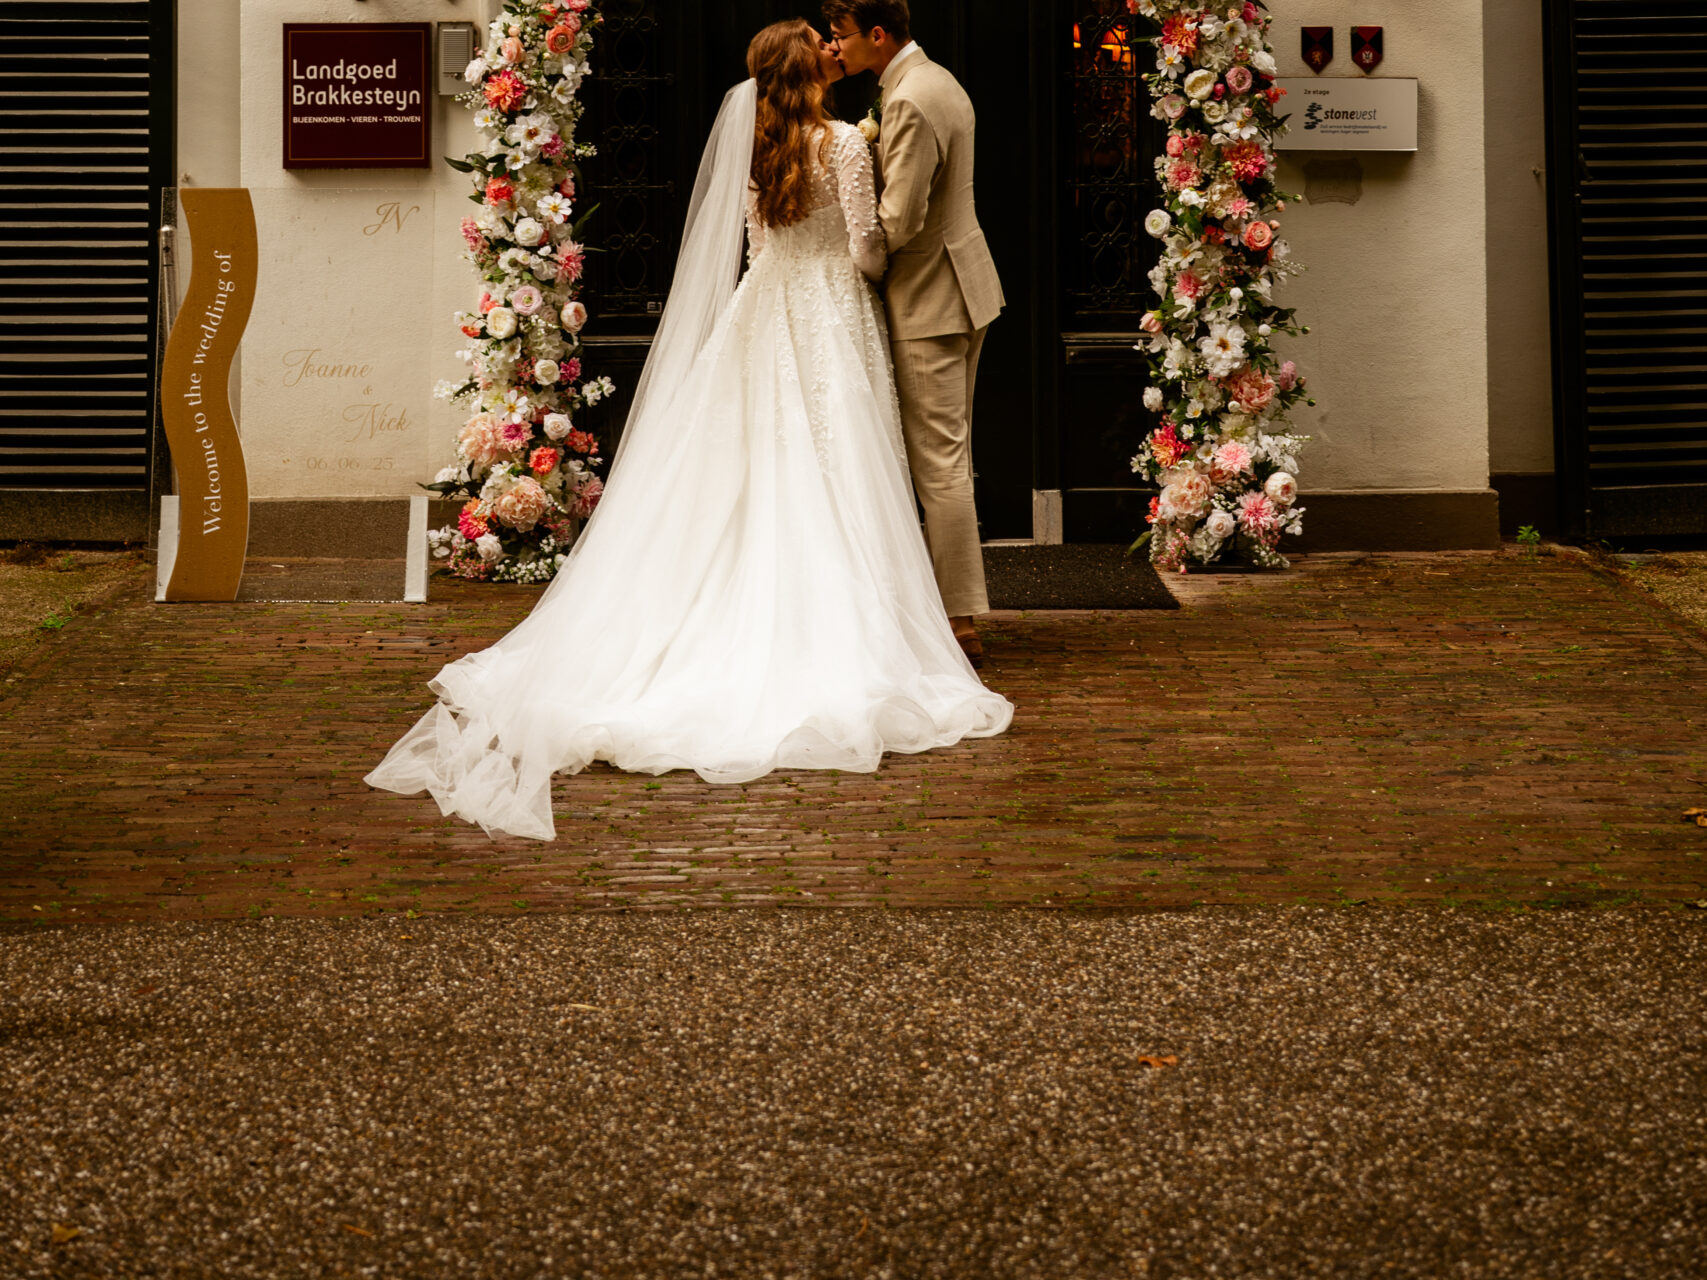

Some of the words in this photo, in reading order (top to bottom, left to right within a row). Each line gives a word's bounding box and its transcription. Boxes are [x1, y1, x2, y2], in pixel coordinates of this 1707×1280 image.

[292, 58, 397, 85] Landgoed
[292, 84, 421, 111] Brakkesteyn
[1323, 108, 1377, 121] stonevest
[213, 250, 232, 273] of
[192, 279, 236, 364] wedding
[282, 348, 372, 388] Joanne
[184, 372, 202, 406] the
[362, 385, 373, 396] &
[195, 412, 209, 433] to
[342, 403, 411, 443] Nick
[202, 438, 222, 535] Welcome
